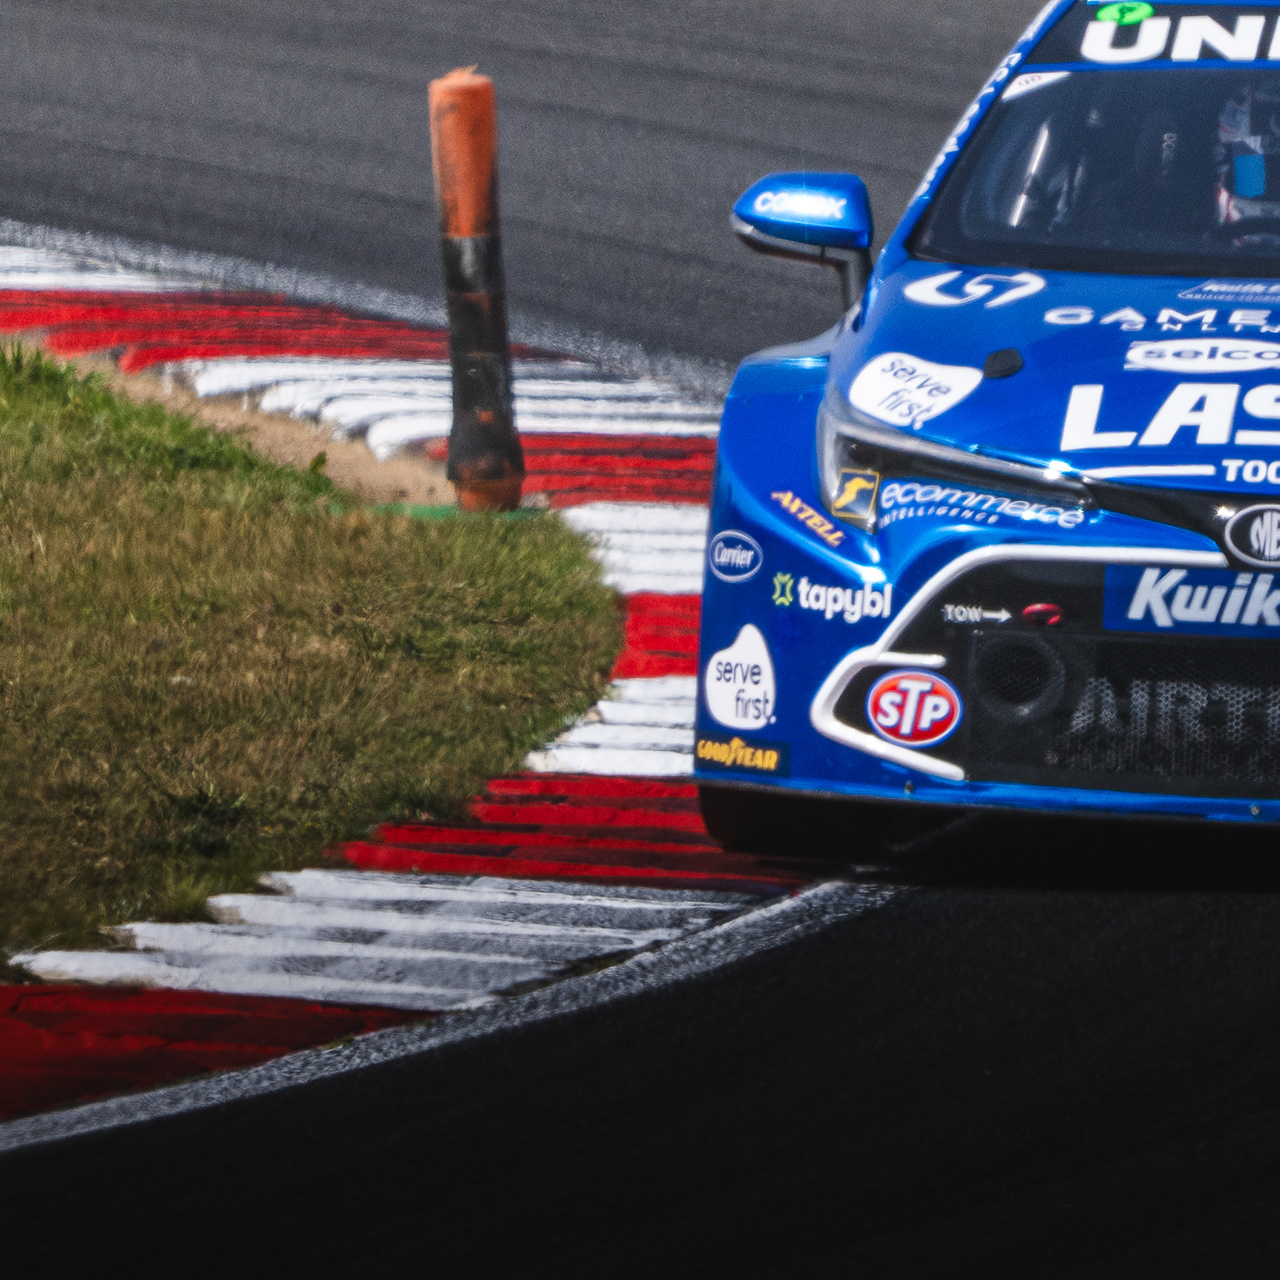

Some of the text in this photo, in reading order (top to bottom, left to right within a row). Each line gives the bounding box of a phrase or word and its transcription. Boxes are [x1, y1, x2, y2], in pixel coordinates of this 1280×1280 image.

[881, 359, 952, 397] serve
[879, 505, 1000, 529] INTELLIGENCE
[880, 482, 1085, 529] ecommerce
[714, 540, 756, 568] Carrier
[798, 576, 893, 624] tapybl
[943, 604, 982, 623] TOW
[715, 661, 762, 685] serve
[877, 678, 951, 736] STP
